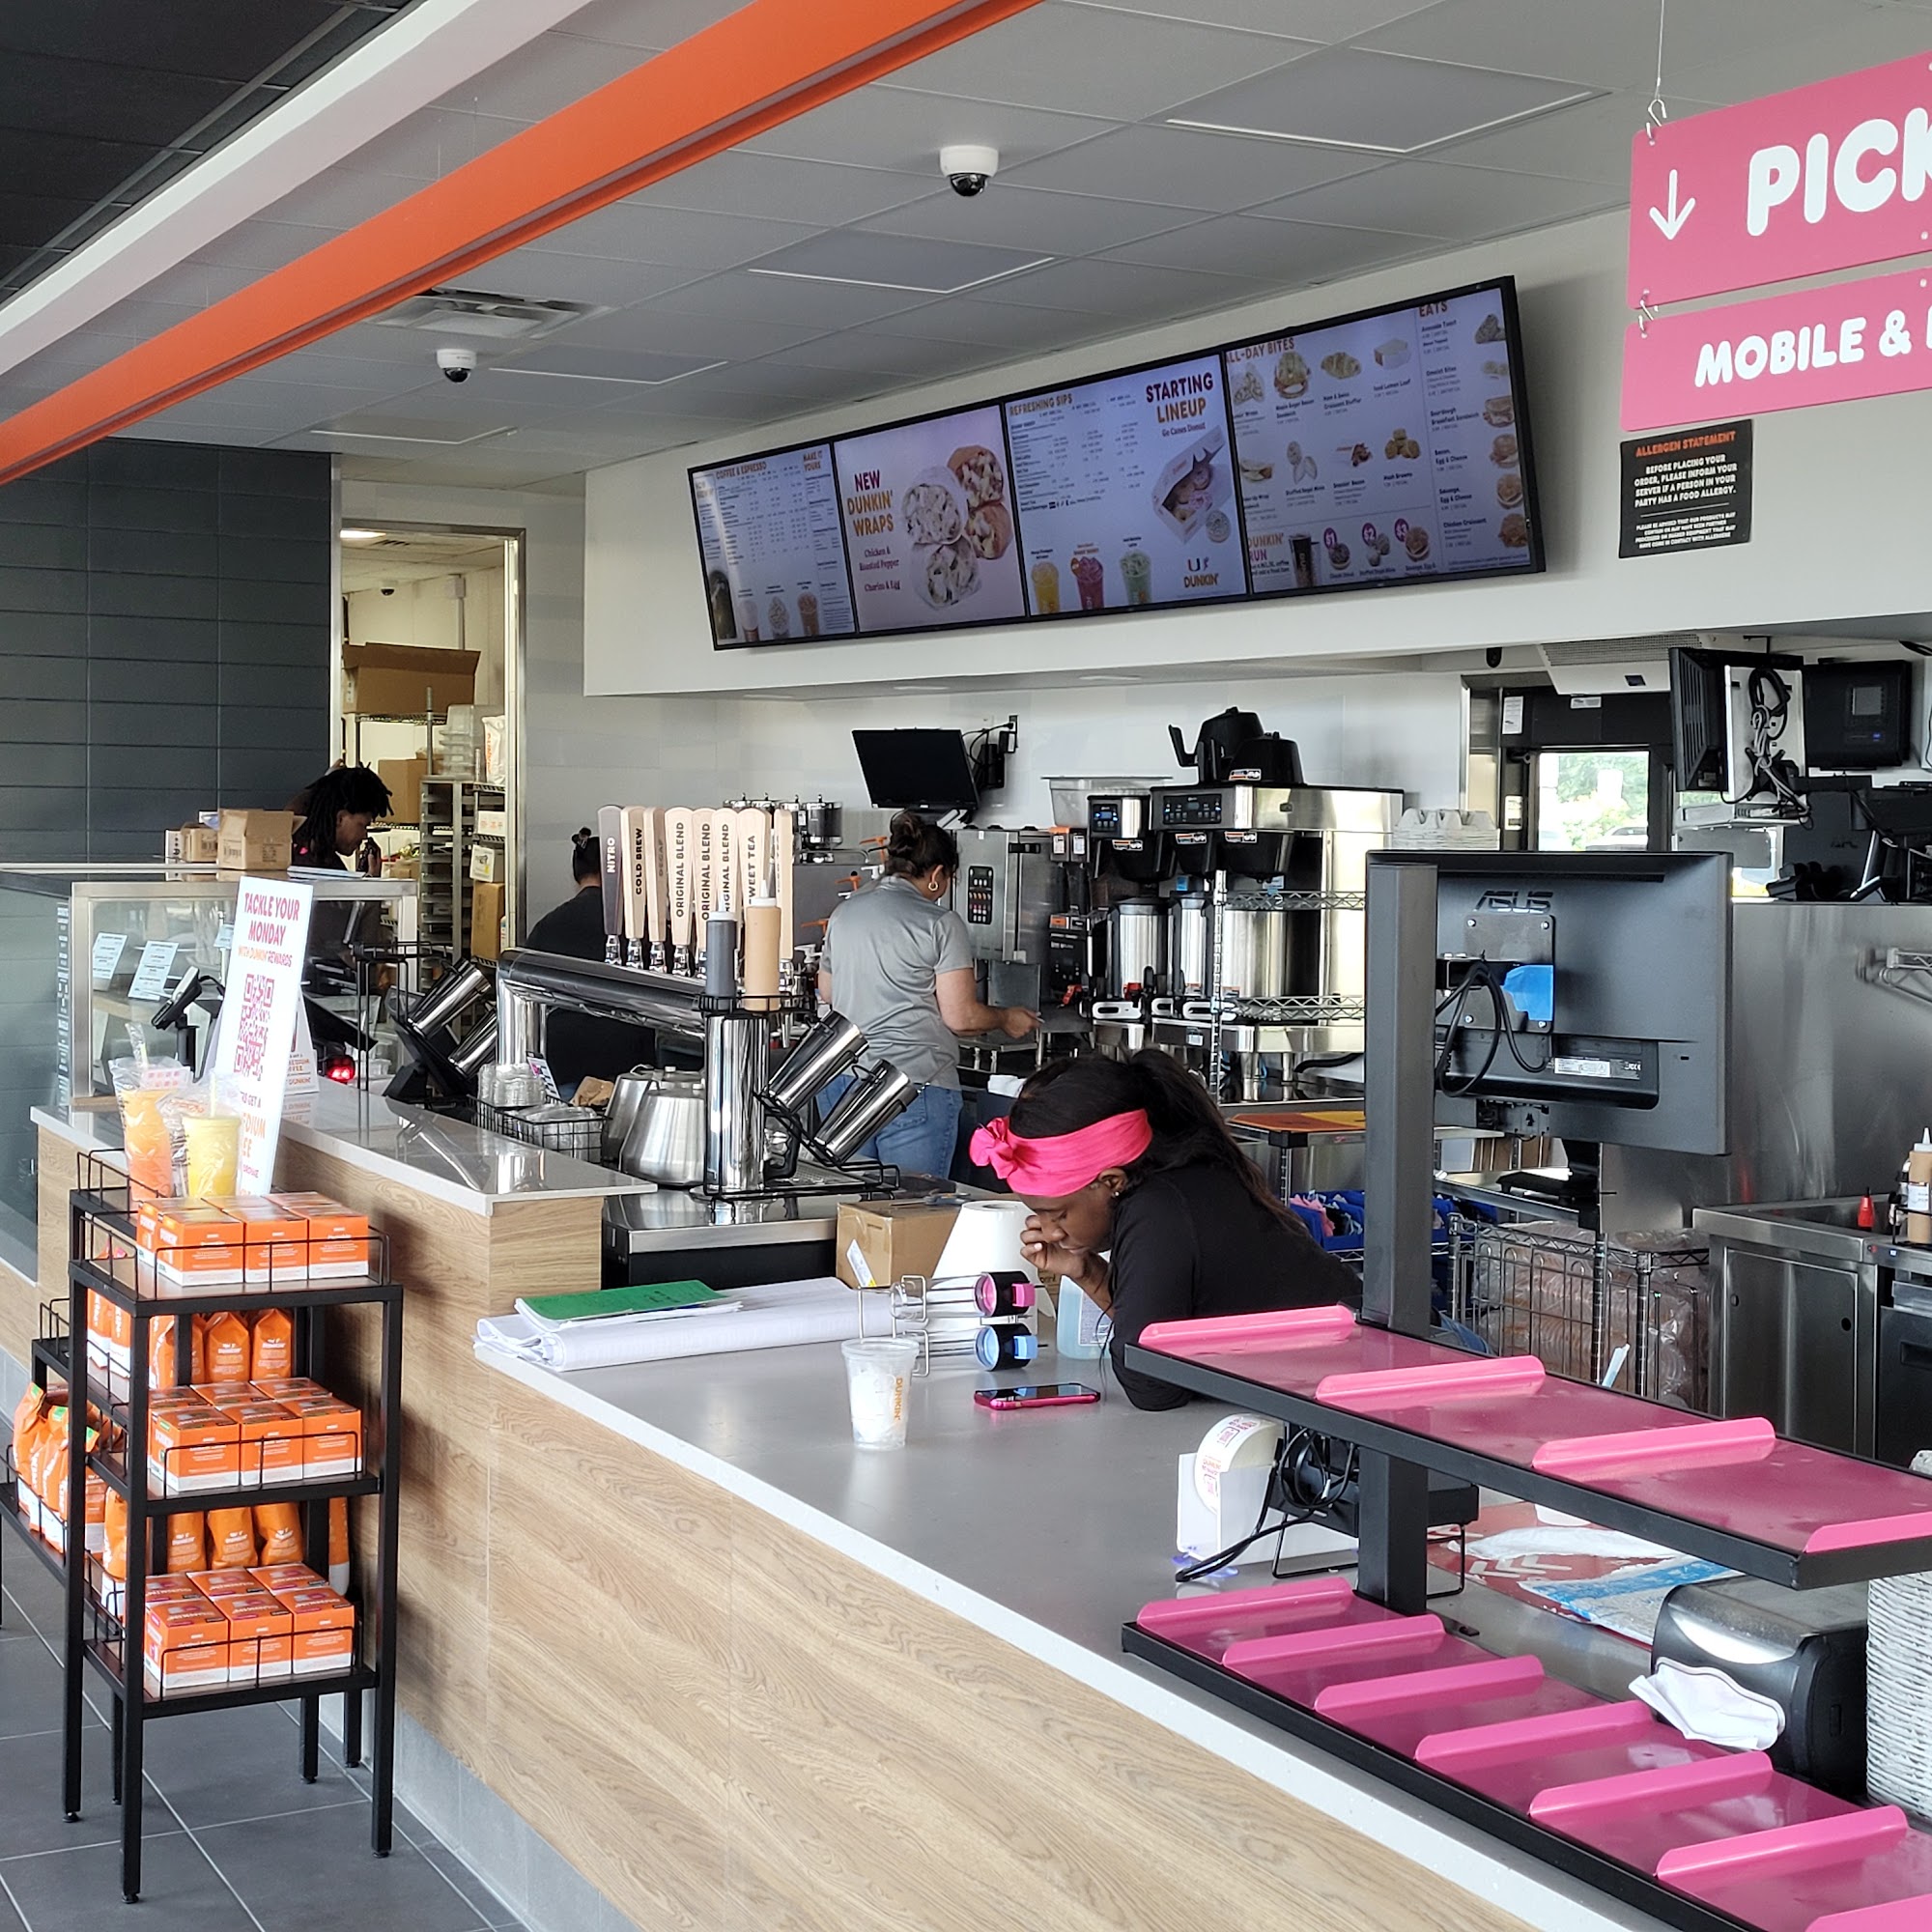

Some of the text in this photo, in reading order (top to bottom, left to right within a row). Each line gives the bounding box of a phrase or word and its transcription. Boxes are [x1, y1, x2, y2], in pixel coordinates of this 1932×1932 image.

[1419, 300, 1448, 317] EATS
[1267, 337, 1294, 355] BITES
[1694, 309, 1912, 388] MOBILE &
[1146, 373, 1213, 404] STARTING
[1009, 392, 1073, 416] REFRESHING SIPS
[1156, 397, 1207, 423] LINEUP
[1636, 431, 1736, 457] ALLERGEN STATEMENT
[716, 468, 735, 480] COFFEE
[741, 461, 768, 474] ESPRESSO
[1634, 463, 1737, 487] ORDER, PLEASE INFORM YOUR
[1646, 454, 1725, 474] BEFORE PLACING YOUR
[854, 469, 880, 492] NEW
[1635, 474, 1736, 497] SERVER IF A PERSON IN YOUR
[847, 490, 893, 515] DUNKIN'
[1634, 485, 1737, 508] PARTY HAS A FOOD ALLERGY.
[853, 513, 894, 536] WRAPS
[1363, 526, 1376, 540] $2
[1325, 533, 1336, 546] $1
[865, 548, 885, 556] Chicken
[1250, 550, 1267, 562] RUN
[881, 559, 899, 571] Pepper
[1184, 573, 1219, 587] DUNKIN'
[607, 837, 615, 873] NITRO
[701, 822, 711, 920] ORIGINAL BLEND
[722, 866, 730, 912] IGINAL
[748, 863, 756, 905] WEET
[244, 893, 299, 921] TACKLE YOUR
[1473, 890, 1554, 915] ASUS
[248, 920, 286, 946] MONDAY
[268, 951, 293, 968] REWARDS
[895, 1377, 903, 1421] DUNKIN'
